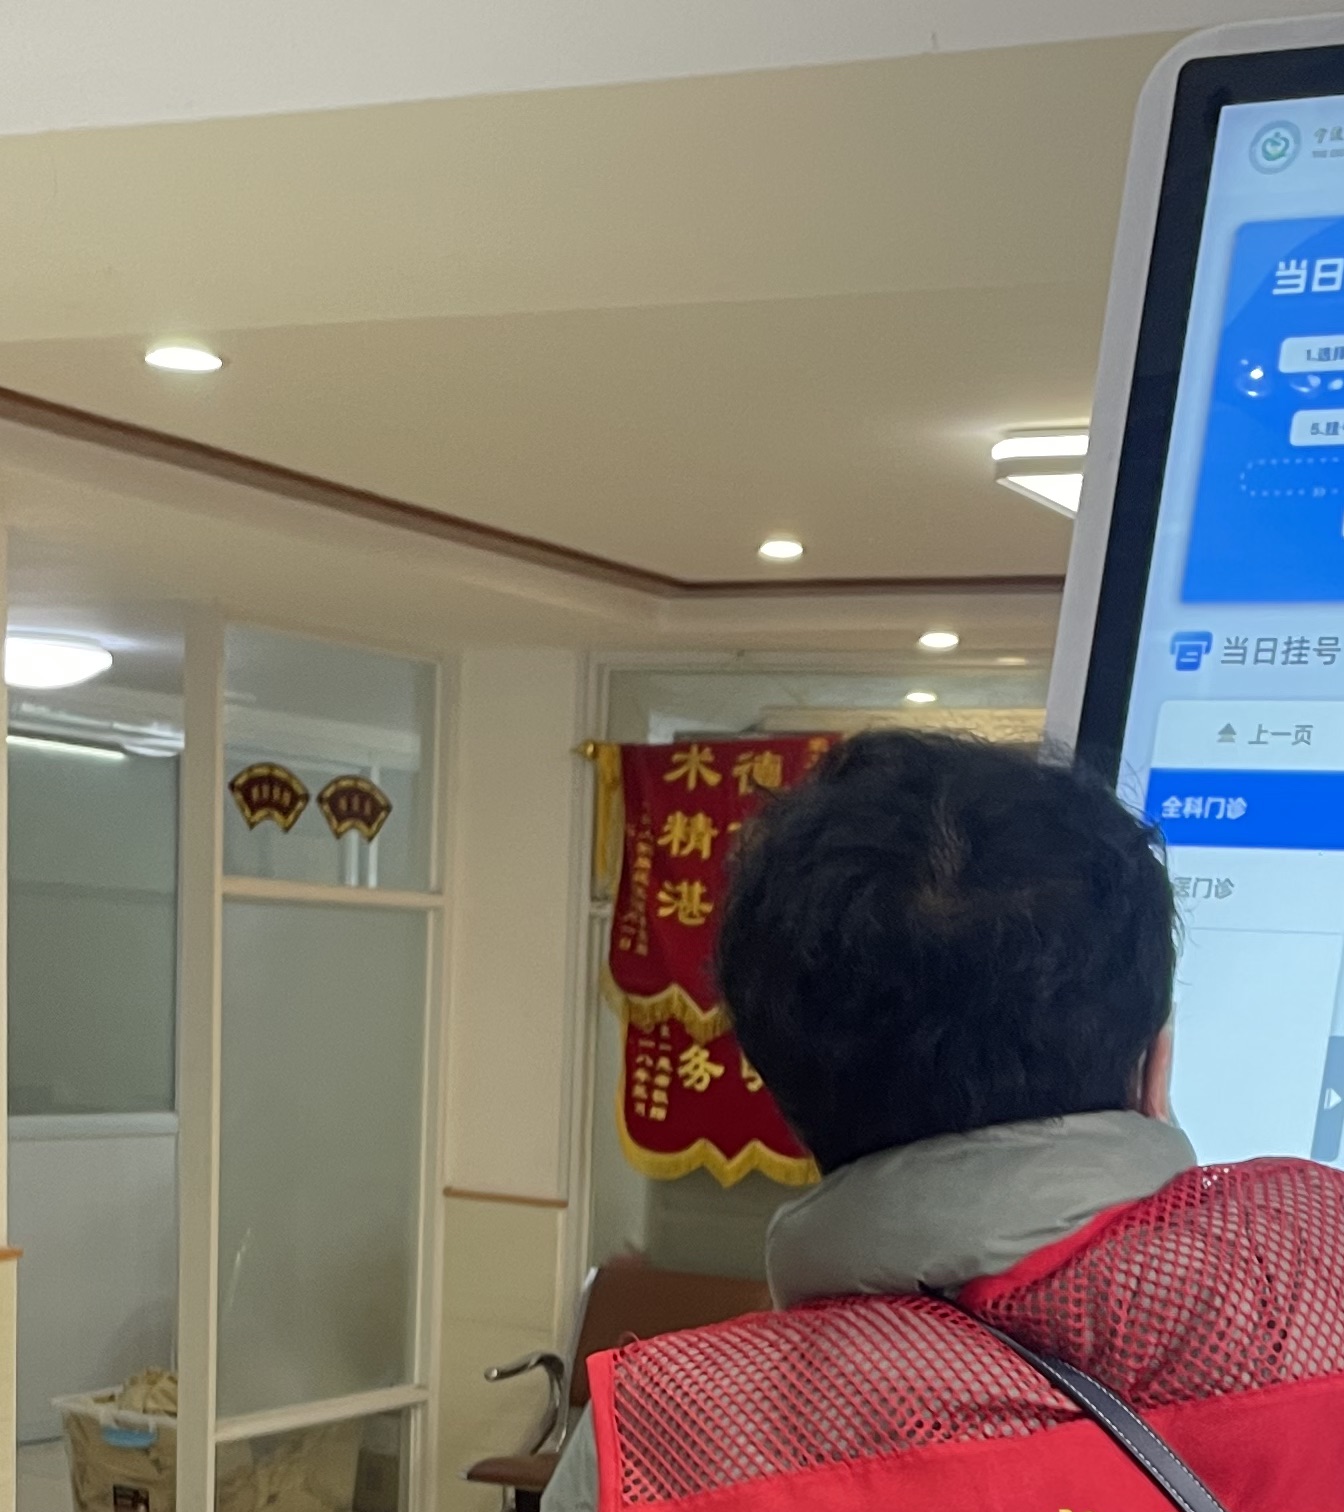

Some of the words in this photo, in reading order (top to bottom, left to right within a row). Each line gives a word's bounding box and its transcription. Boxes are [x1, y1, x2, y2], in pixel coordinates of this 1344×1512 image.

[1220, 635, 1342, 666] 当日挂号
[1248, 723, 1314, 746] 上一页
[1161, 796, 1247, 820] 全科门诊
